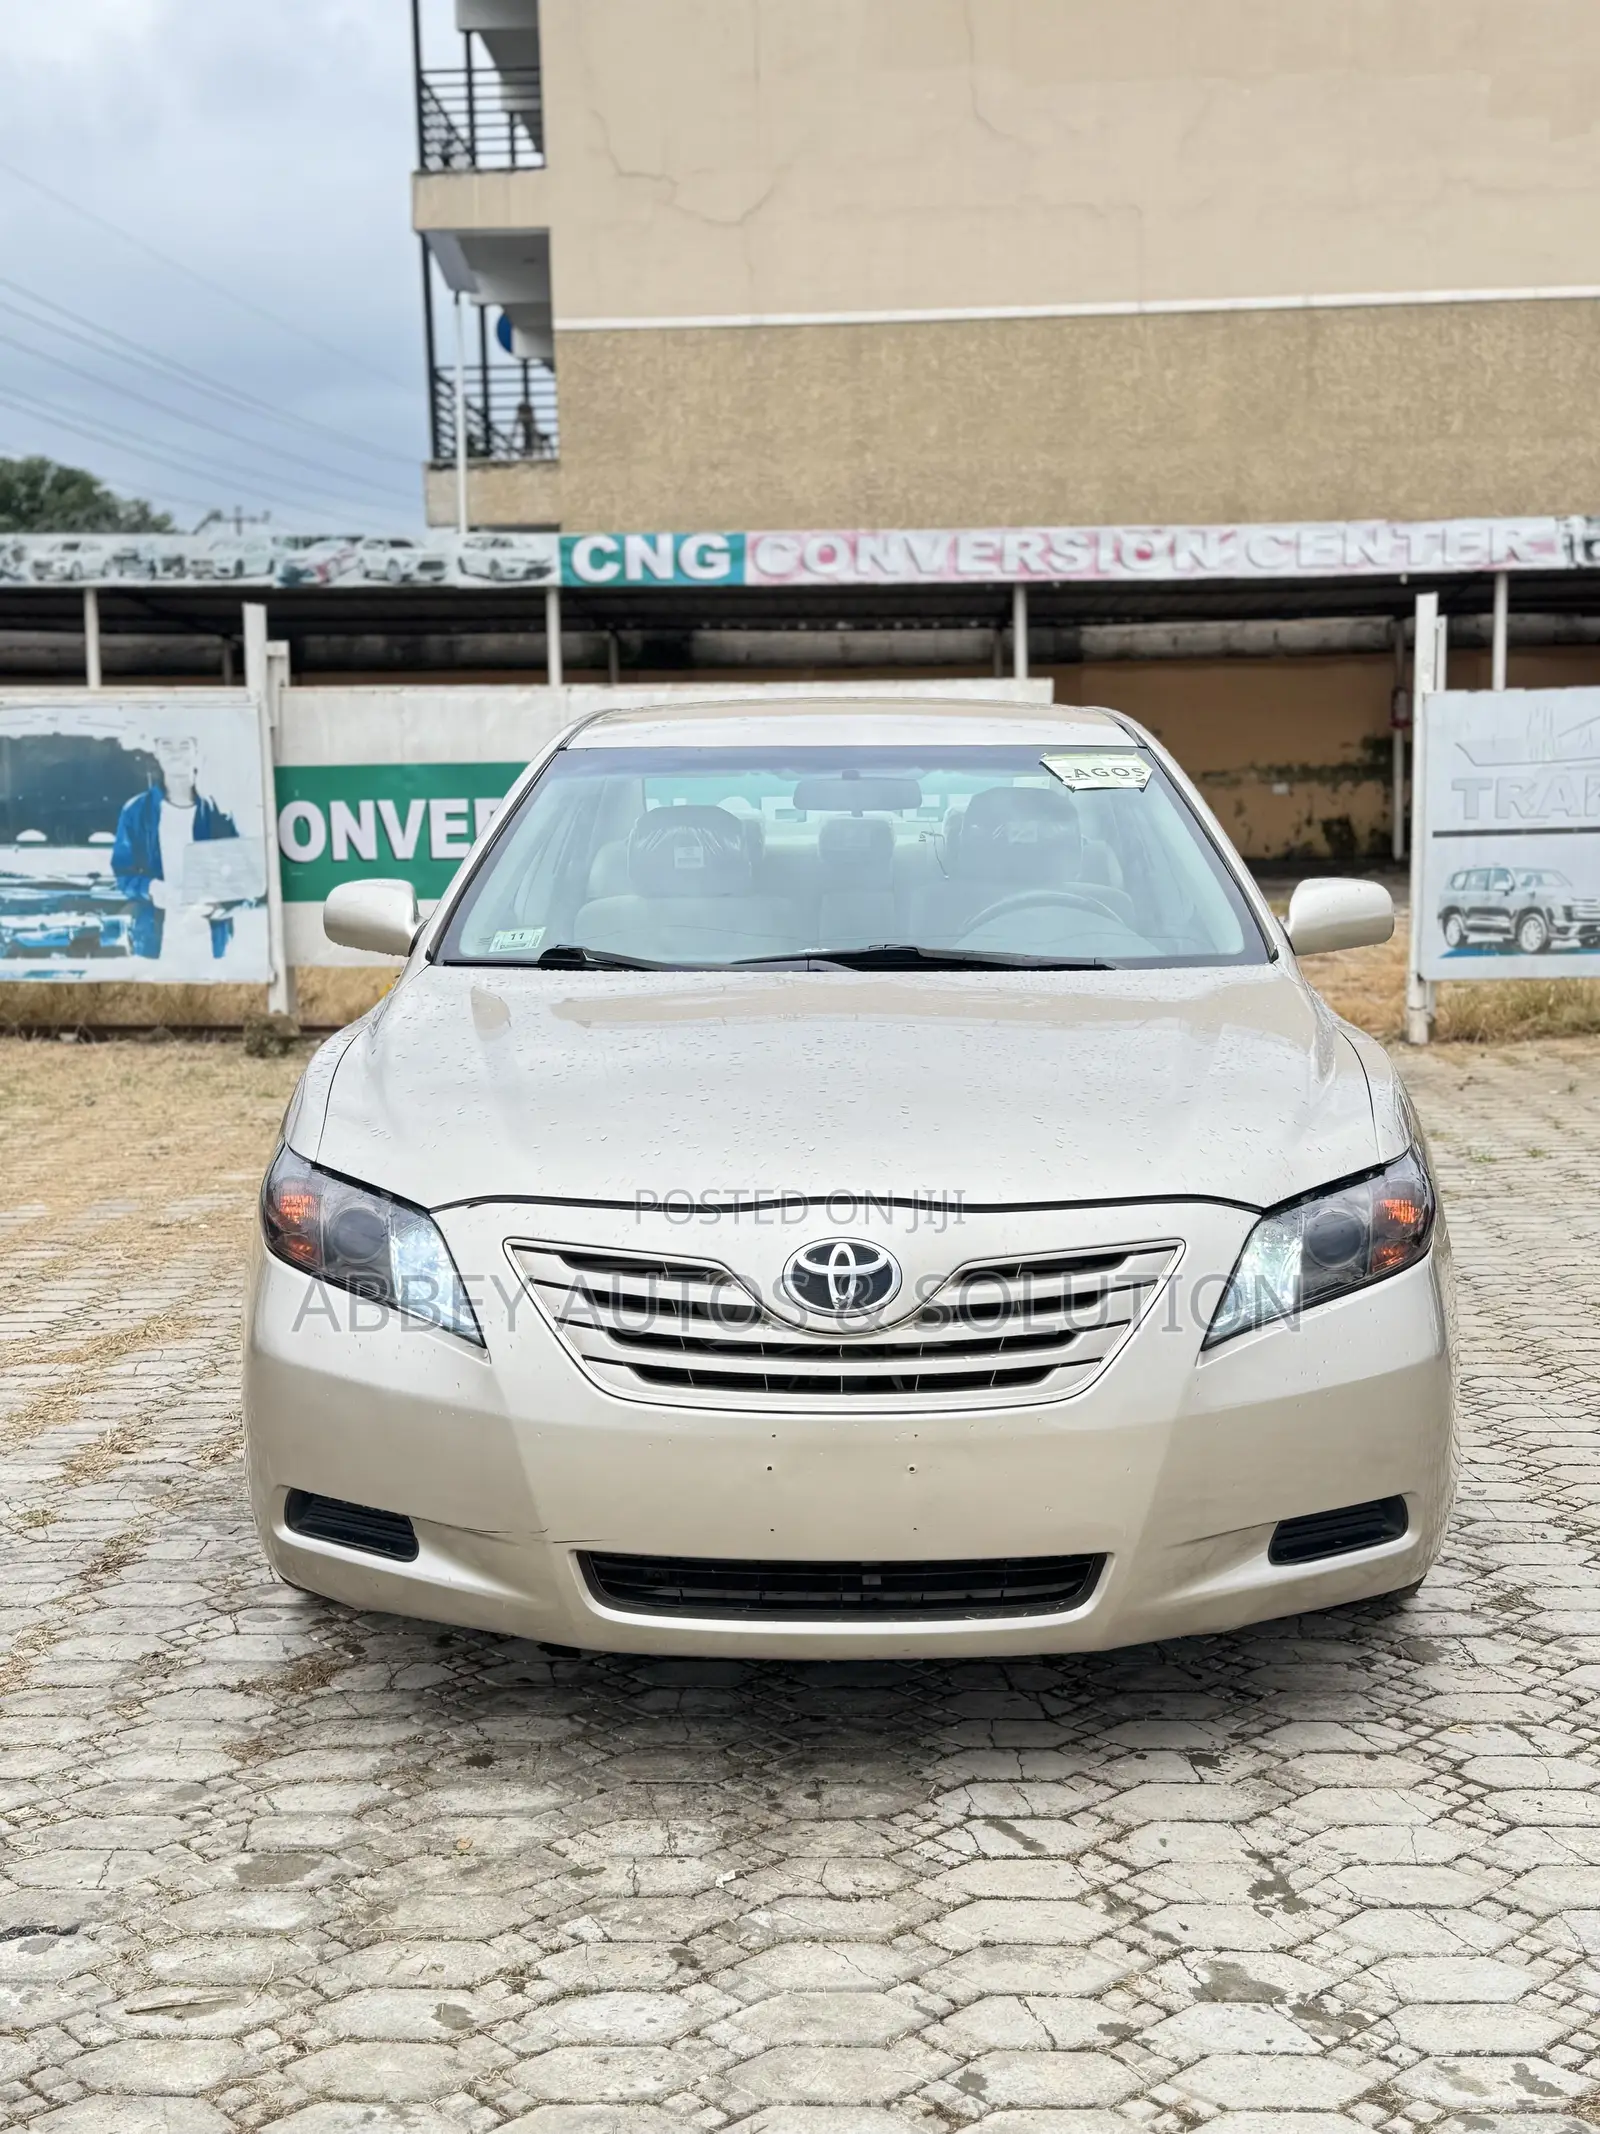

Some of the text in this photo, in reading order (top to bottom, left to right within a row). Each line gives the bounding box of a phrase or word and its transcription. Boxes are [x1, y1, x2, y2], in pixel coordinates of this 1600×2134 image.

[571, 533, 732, 582] CNG
[751, 526, 1228, 574] CONVERSION
[1245, 522, 1536, 570] CENTER
